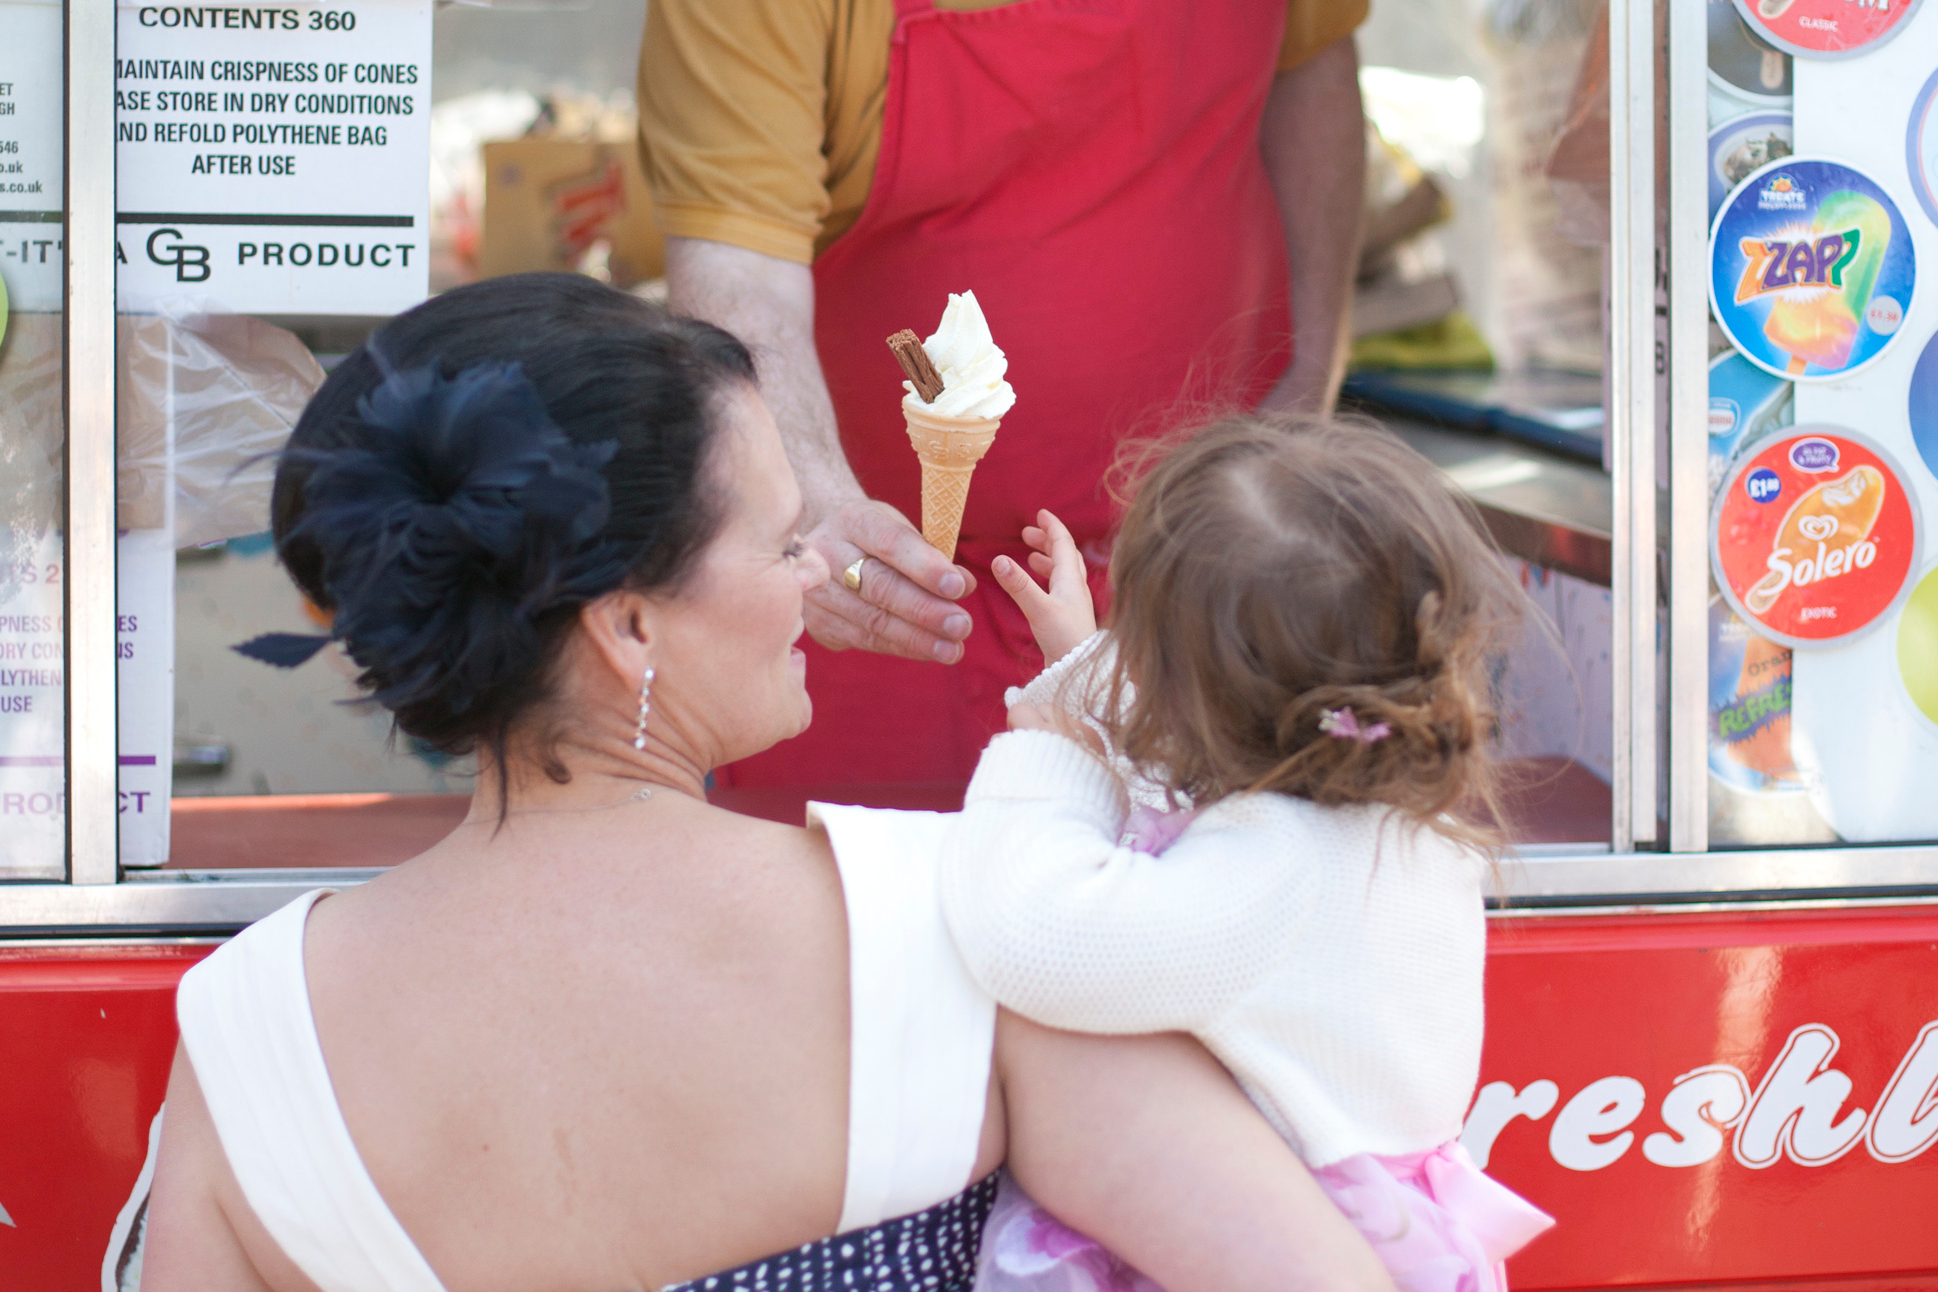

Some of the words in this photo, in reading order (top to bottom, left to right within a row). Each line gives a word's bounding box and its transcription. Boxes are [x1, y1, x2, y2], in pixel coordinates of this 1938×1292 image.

[139, 7, 300, 30] CONTENTS
[308, 9, 357, 31] 360
[1799, 16, 1839, 32] CLASSIC
[211, 60, 319, 82] CRISPNESS
[325, 63, 348, 83] OF
[354, 63, 418, 84] CONES
[157, 91, 218, 112] STORE
[224, 92, 244, 112] IN
[251, 93, 289, 113] DRY
[294, 94, 414, 115] CONDITIONS
[117, 122, 147, 142] ND
[154, 123, 226, 143] REFOLD
[232, 124, 341, 145] POLYTHENE
[347, 126, 388, 146] BAG
[191, 154, 252, 174] AFTER
[258, 155, 296, 175] USE
[146, 228, 211, 282] GB
[238, 242, 415, 267] PRODUCT
[1757, 540, 1877, 596] Solero
[1800, 606, 1838, 620] EXOTIC
[1, 695, 33, 713] USE
